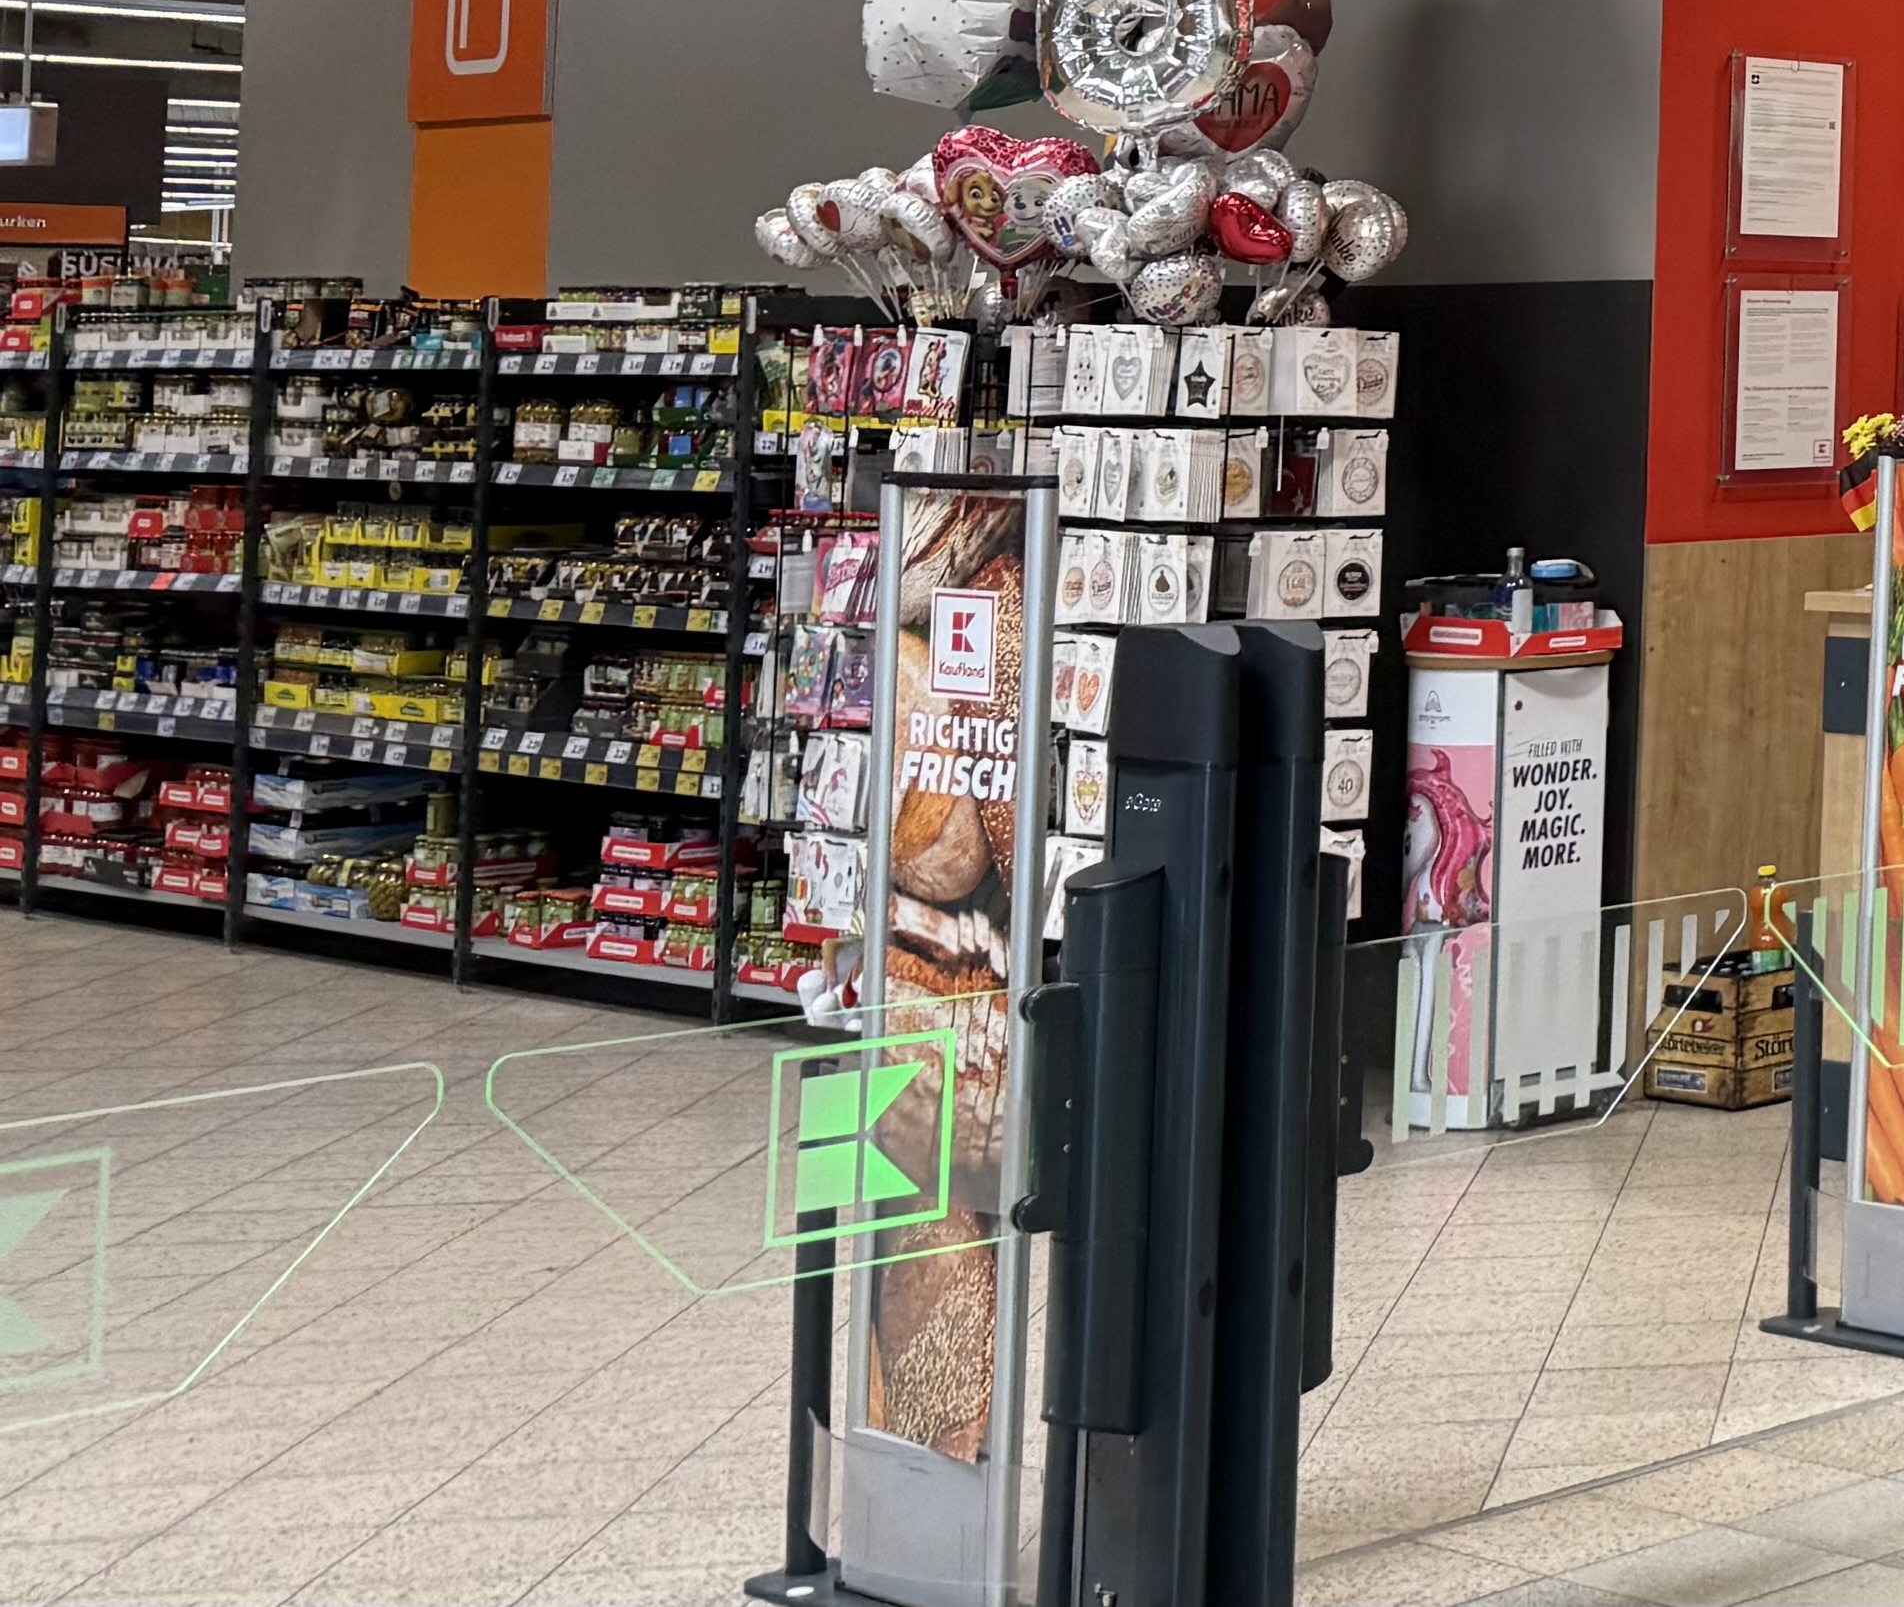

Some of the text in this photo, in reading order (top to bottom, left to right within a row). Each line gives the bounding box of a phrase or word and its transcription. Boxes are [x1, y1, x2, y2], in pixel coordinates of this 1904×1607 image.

[939, 659, 985, 679] Kaufland
[909, 712, 1015, 755] RICHTIG
[1529, 739, 1582, 758] FILLED WITH
[900, 751, 1016, 802] FRISCH
[1513, 758, 1597, 788] WONDER.
[1534, 787, 1572, 813] JOY.
[1520, 813, 1585, 842] MAGIC.
[1522, 841, 1580, 870] MORE.
